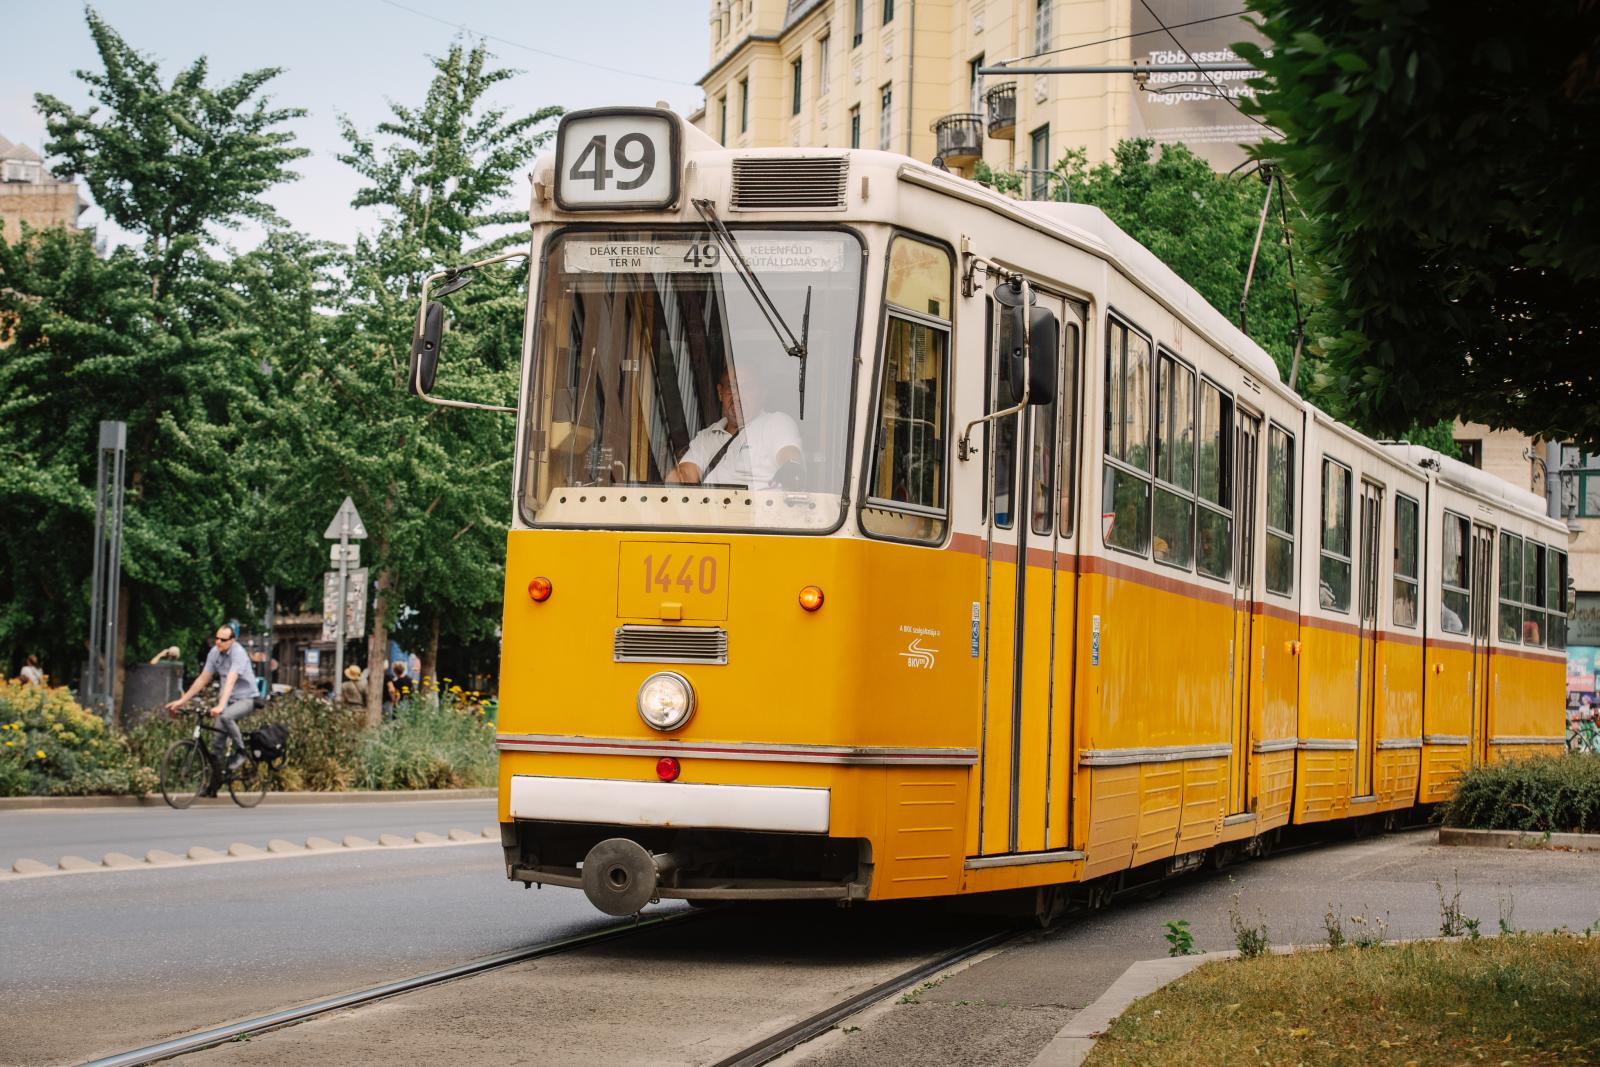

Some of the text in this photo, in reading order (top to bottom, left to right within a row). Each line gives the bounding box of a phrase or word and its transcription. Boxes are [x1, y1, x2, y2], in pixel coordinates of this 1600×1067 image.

[1149, 50, 1187, 65] Több
[570, 132, 656, 191] 49
[590, 244, 662, 256] DEÁK FERENC
[683, 243, 721, 268] 49
[750, 244, 813, 256] KELENFÖLD
[609, 256, 641, 267] TÉR M
[643, 554, 717, 595] 1440
[908, 657, 920, 668] BKV
